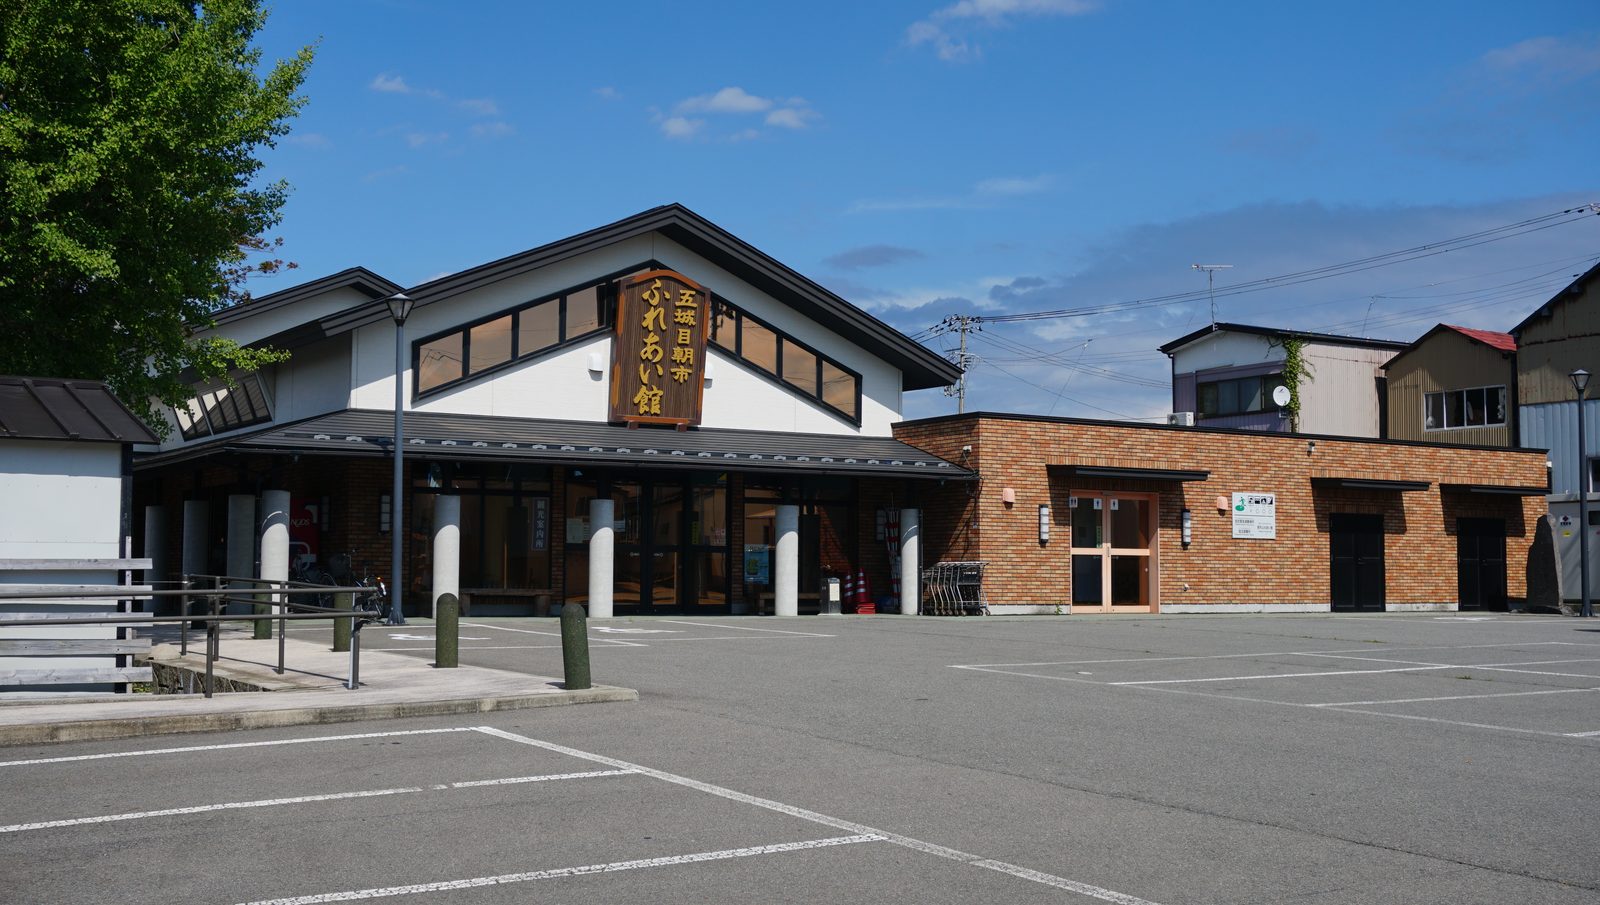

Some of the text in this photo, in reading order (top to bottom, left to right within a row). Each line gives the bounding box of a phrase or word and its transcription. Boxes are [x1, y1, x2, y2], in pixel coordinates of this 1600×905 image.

[633, 279, 671, 415] ふれあい館
[671, 289, 698, 384] 五城目朝市
